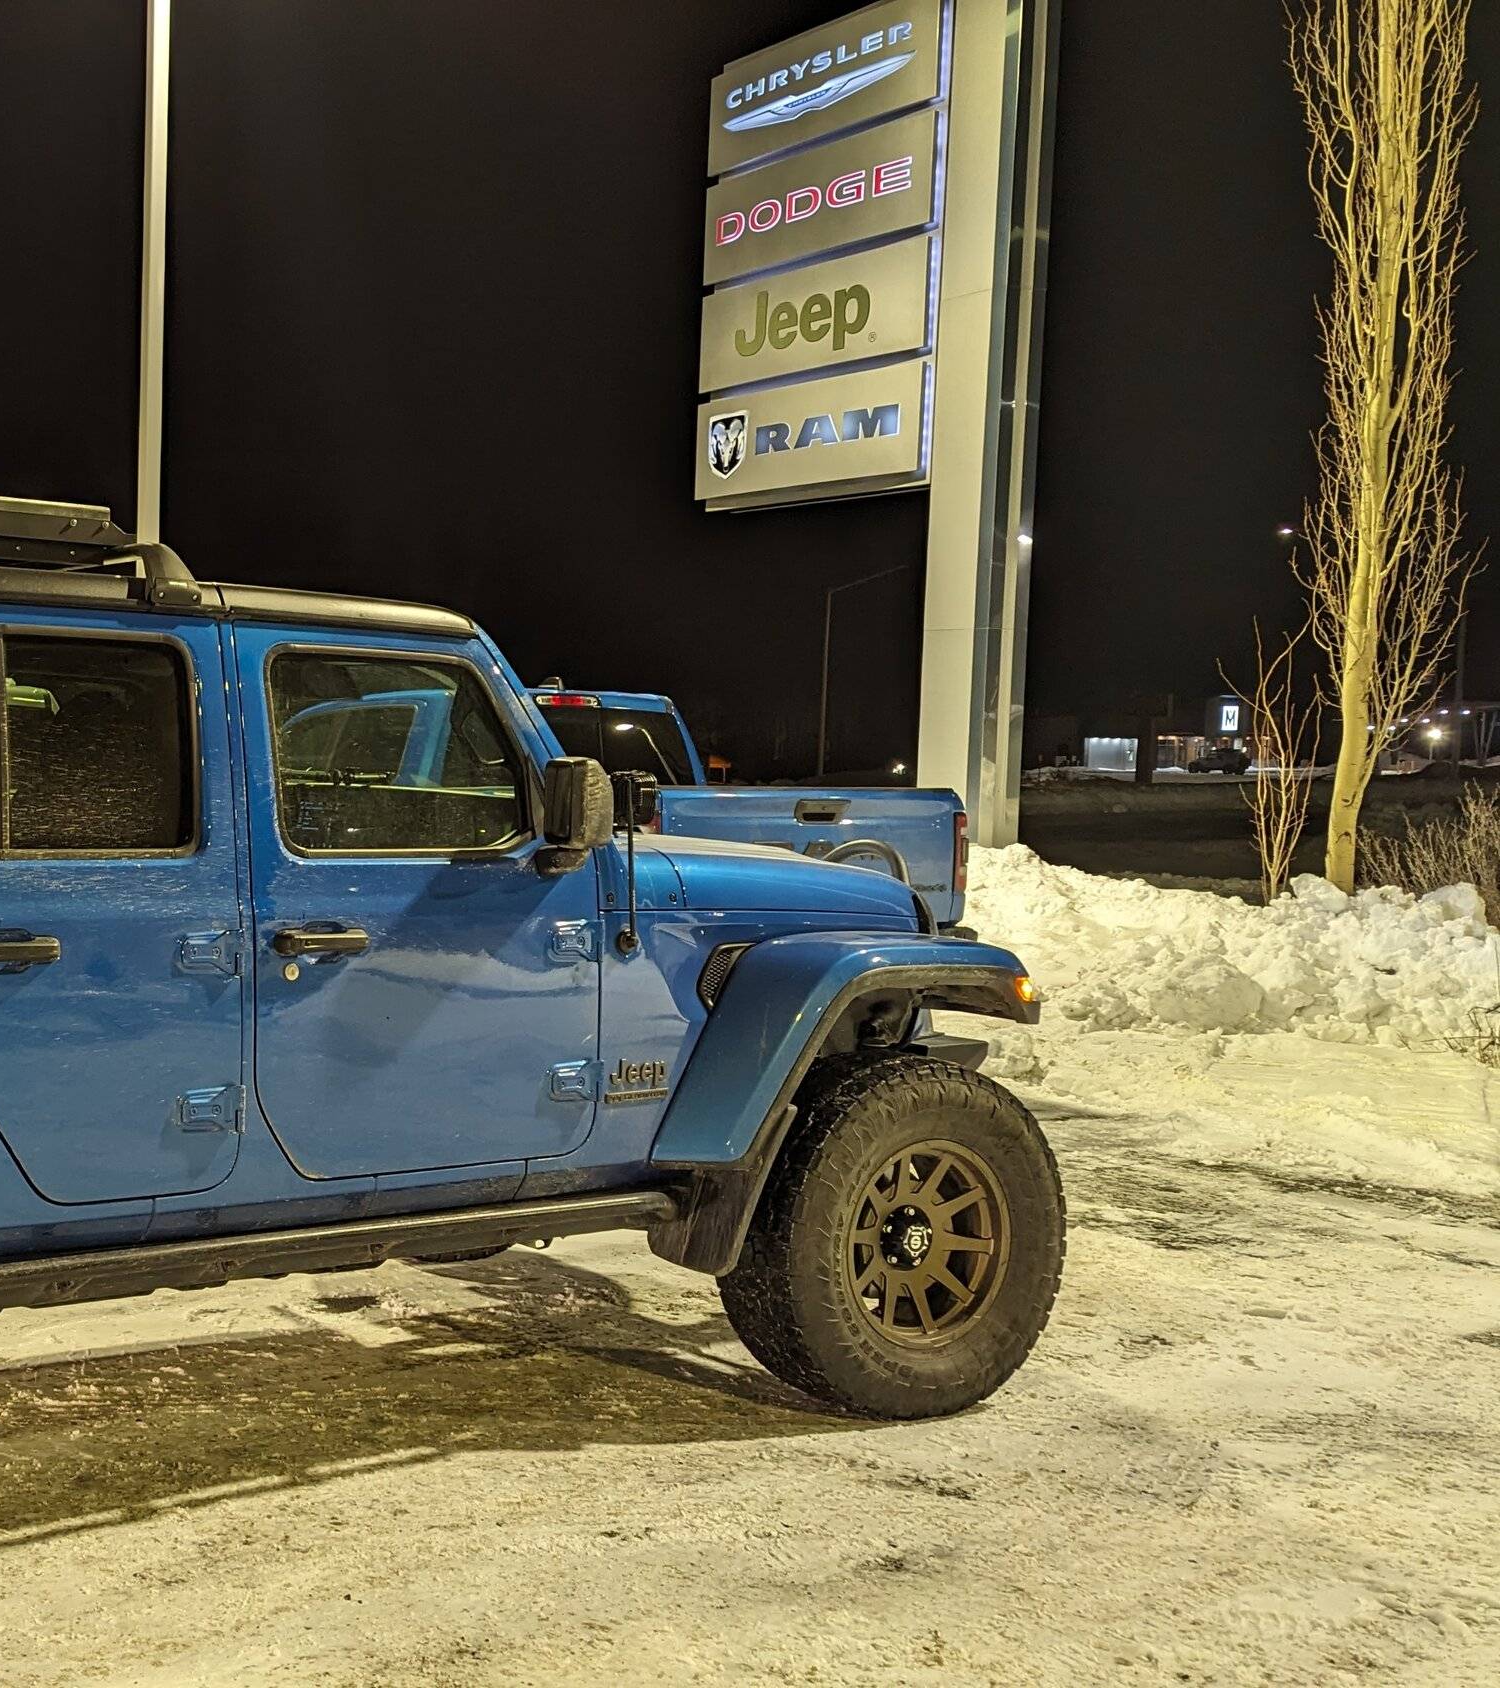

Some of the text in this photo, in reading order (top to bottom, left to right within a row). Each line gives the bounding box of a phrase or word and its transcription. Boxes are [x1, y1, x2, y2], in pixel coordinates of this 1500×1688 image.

[725, 21, 913, 110] CHRYSLER
[715, 155, 913, 248] DODGE
[734, 283, 871, 357] Jeep
[754, 402, 901, 457] RAM
[609, 1058, 668, 1090] Jeep
